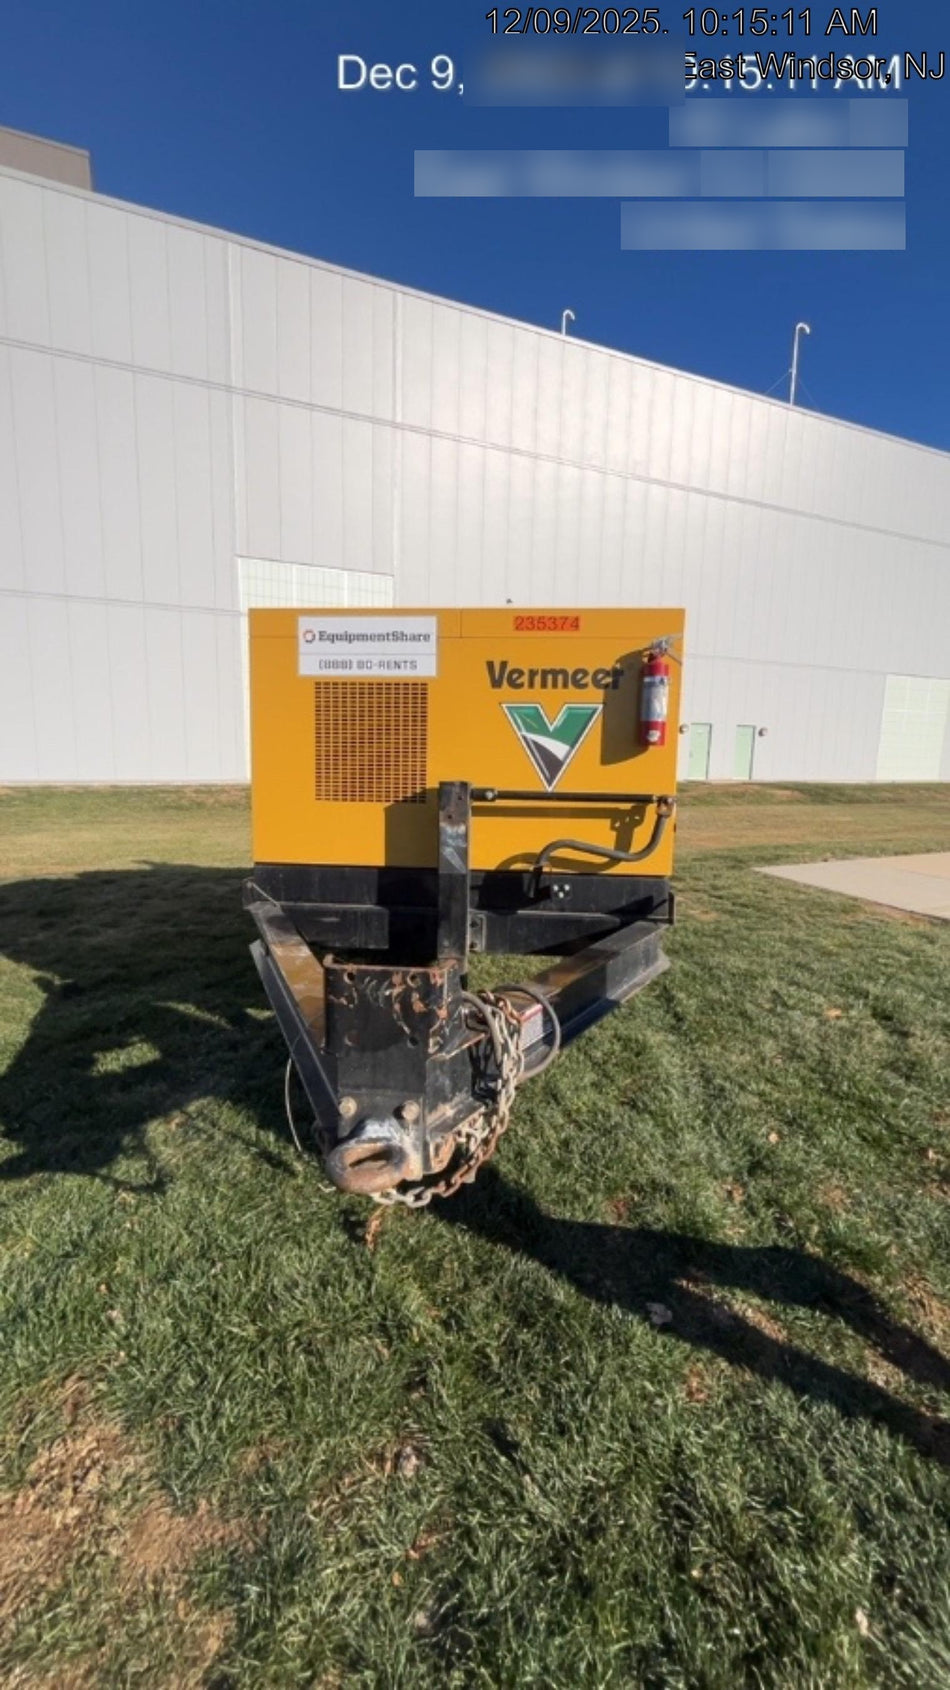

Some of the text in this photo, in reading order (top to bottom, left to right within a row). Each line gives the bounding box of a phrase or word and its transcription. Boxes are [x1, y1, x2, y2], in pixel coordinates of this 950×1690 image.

[514, 615, 580, 632] 235374
[318, 630, 431, 644] EquipmentShare
[485, 660, 625, 690] Vermeer
